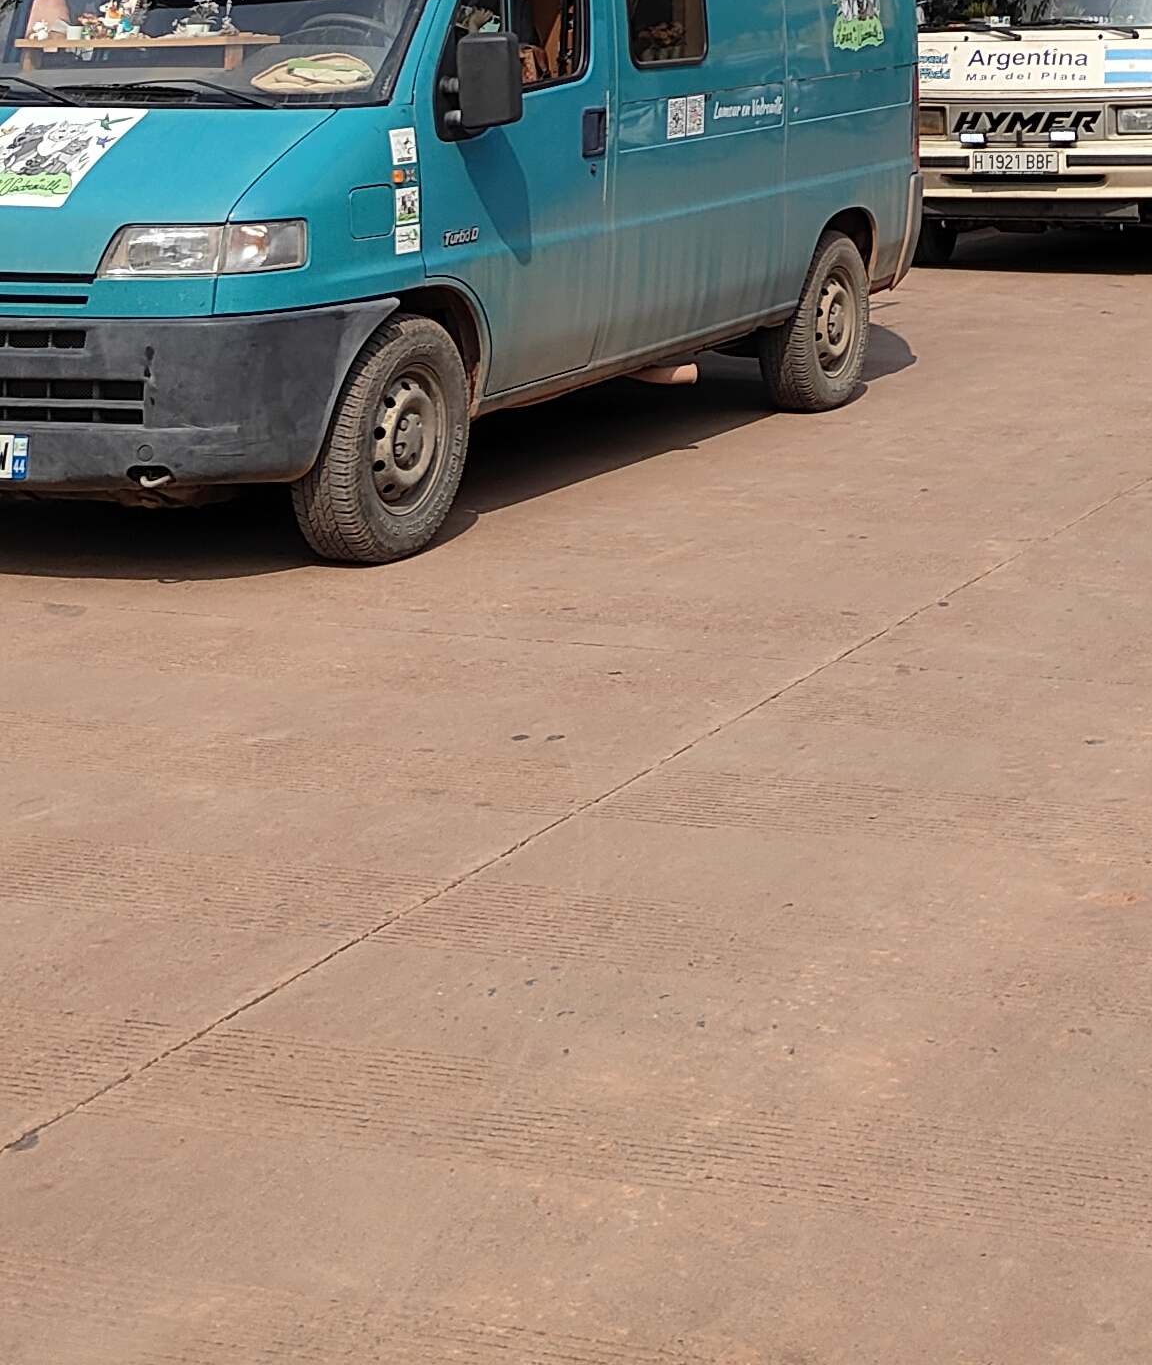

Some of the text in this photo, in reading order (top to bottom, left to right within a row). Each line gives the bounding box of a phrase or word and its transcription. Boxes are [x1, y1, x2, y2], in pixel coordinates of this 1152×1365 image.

[967, 48, 1089, 71] Argentina
[966, 72, 1088, 82] Mar del Plata
[952, 110, 1102, 134] HYMER
[988, 154, 1021, 170] 1921
[1026, 154, 1054, 170] BBF
[444, 226, 480, 247] Turbo D
[13, 458, 26, 474] 44
